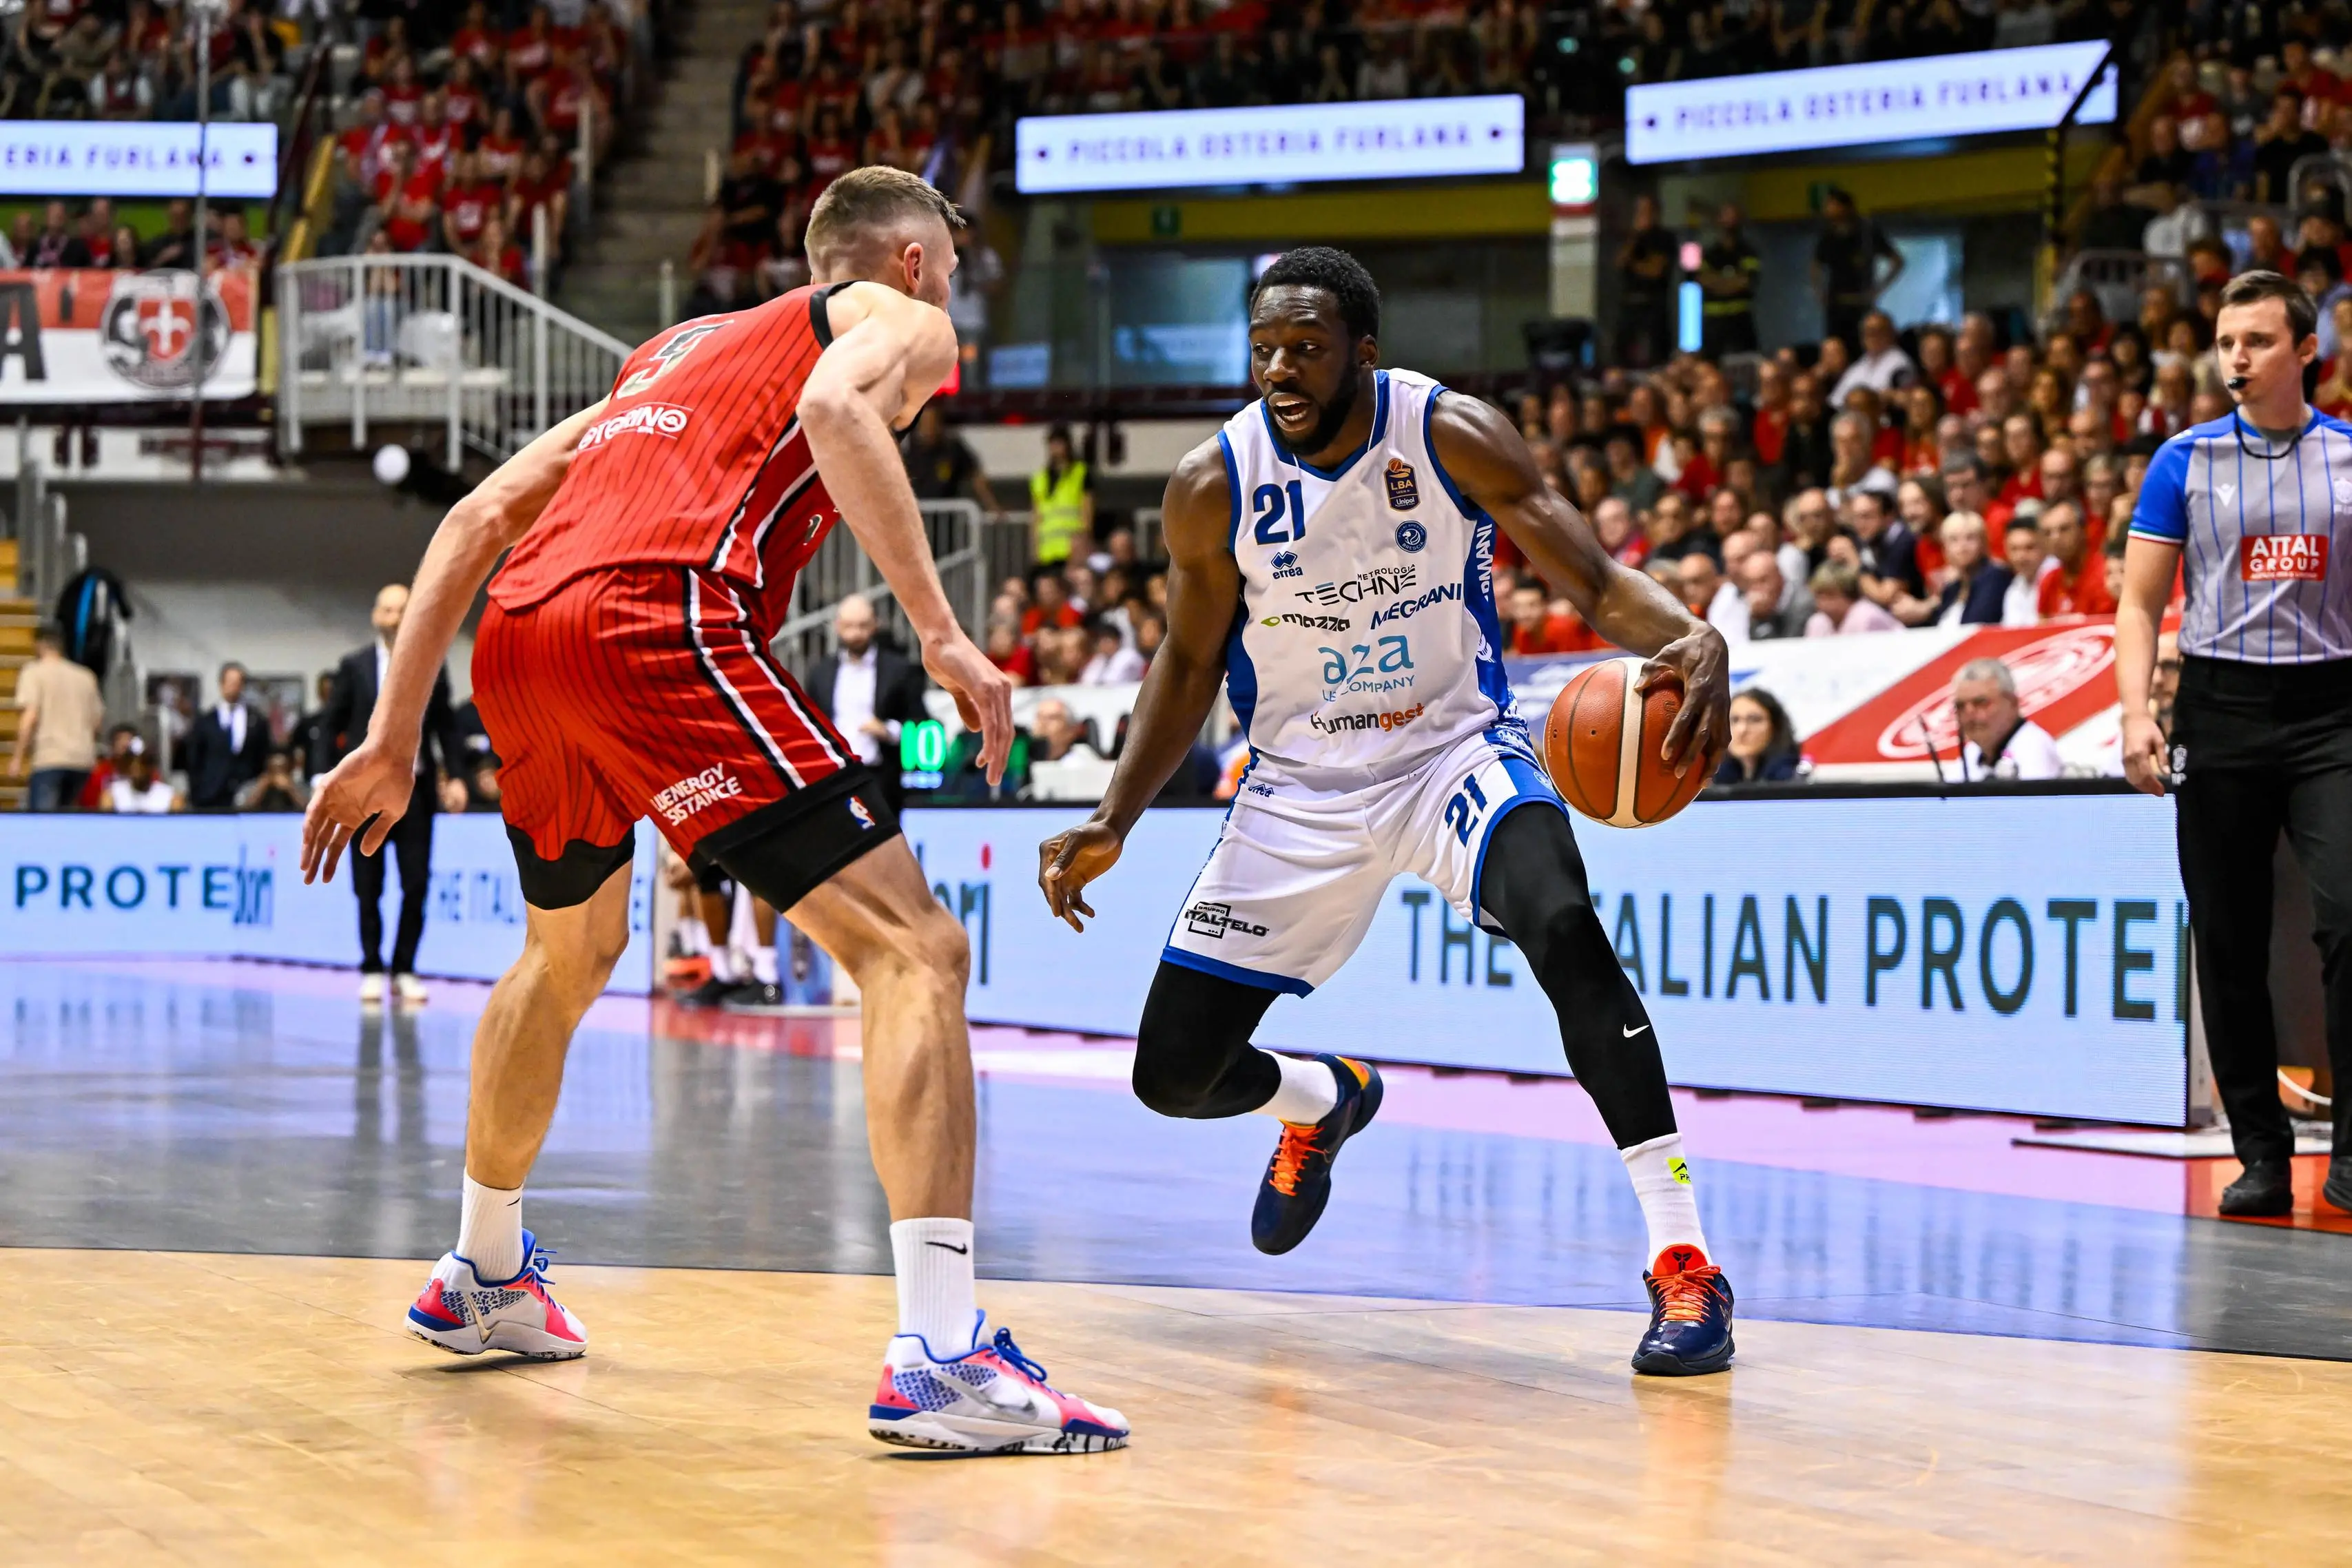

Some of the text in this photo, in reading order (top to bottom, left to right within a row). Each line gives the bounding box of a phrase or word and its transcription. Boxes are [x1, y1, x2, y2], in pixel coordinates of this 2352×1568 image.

[1390, 479, 1414, 491] LBA
[1396, 496, 1415, 506] Unipol
[1252, 479, 1306, 546] 21
[2250, 536, 2320, 557] ATTAL
[1272, 566, 1303, 579] errea
[2249, 557, 2320, 572] GROUP
[1370, 583, 1462, 630] MEGRANI
[1310, 702, 1425, 734] Humangest
[1445, 773, 1488, 849] 21
[1198, 905, 1226, 914] GRUPPO
[1590, 892, 1828, 1004] ALIAN
[1864, 896, 2189, 1022] PROTE
